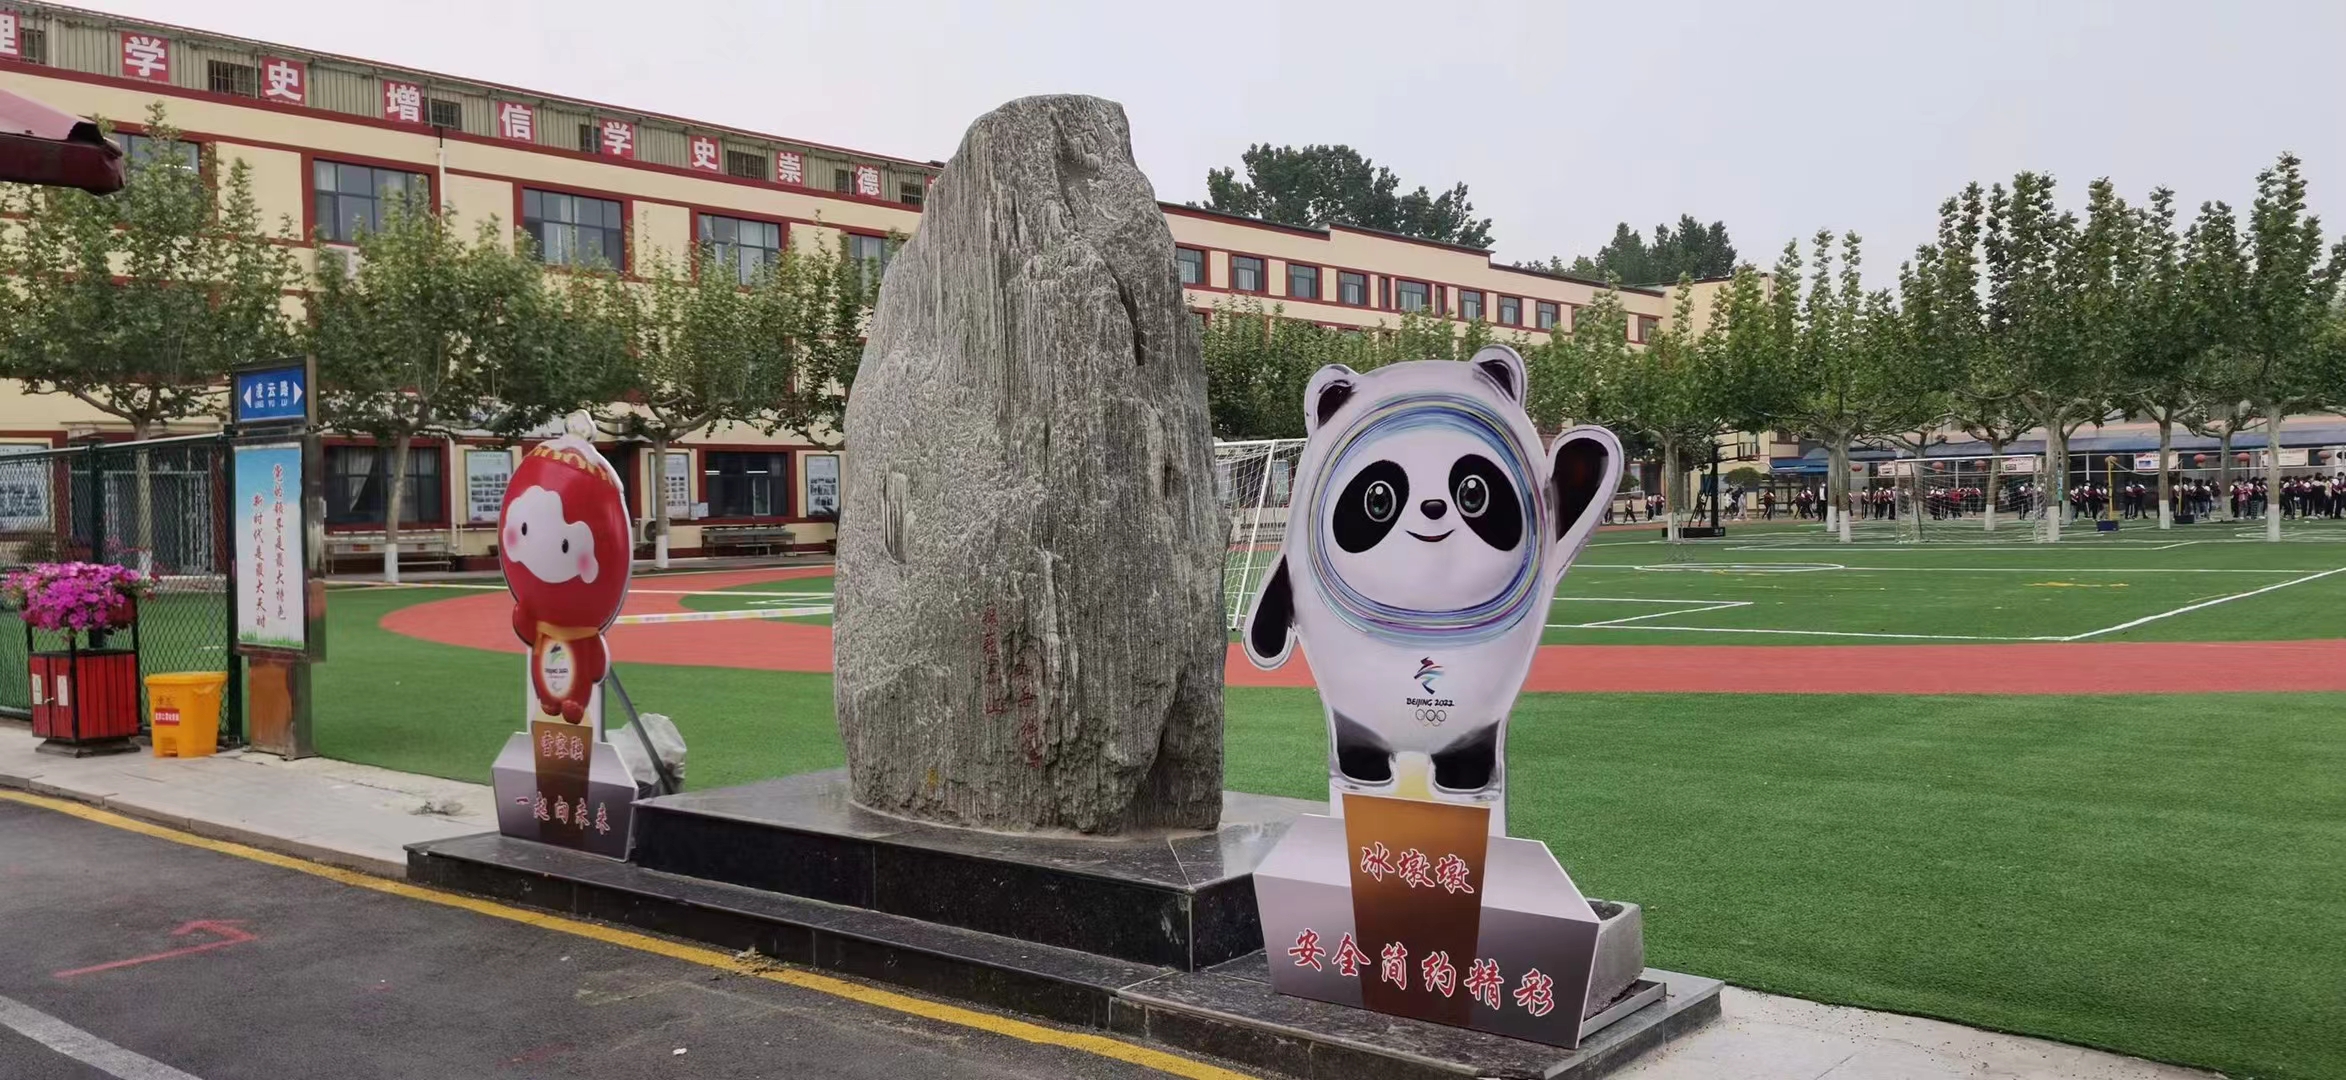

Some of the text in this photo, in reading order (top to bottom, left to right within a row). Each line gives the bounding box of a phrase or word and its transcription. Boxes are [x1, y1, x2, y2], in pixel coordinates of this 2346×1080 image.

[1406, 698, 1455, 707] BEIJING 2022
[541, 730, 584, 760] 雪容融
[516, 791, 611, 835] 一起向未来
[1361, 842, 1475, 894] 冰墩墩
[1288, 928, 1555, 1017] 安全简约精彩
